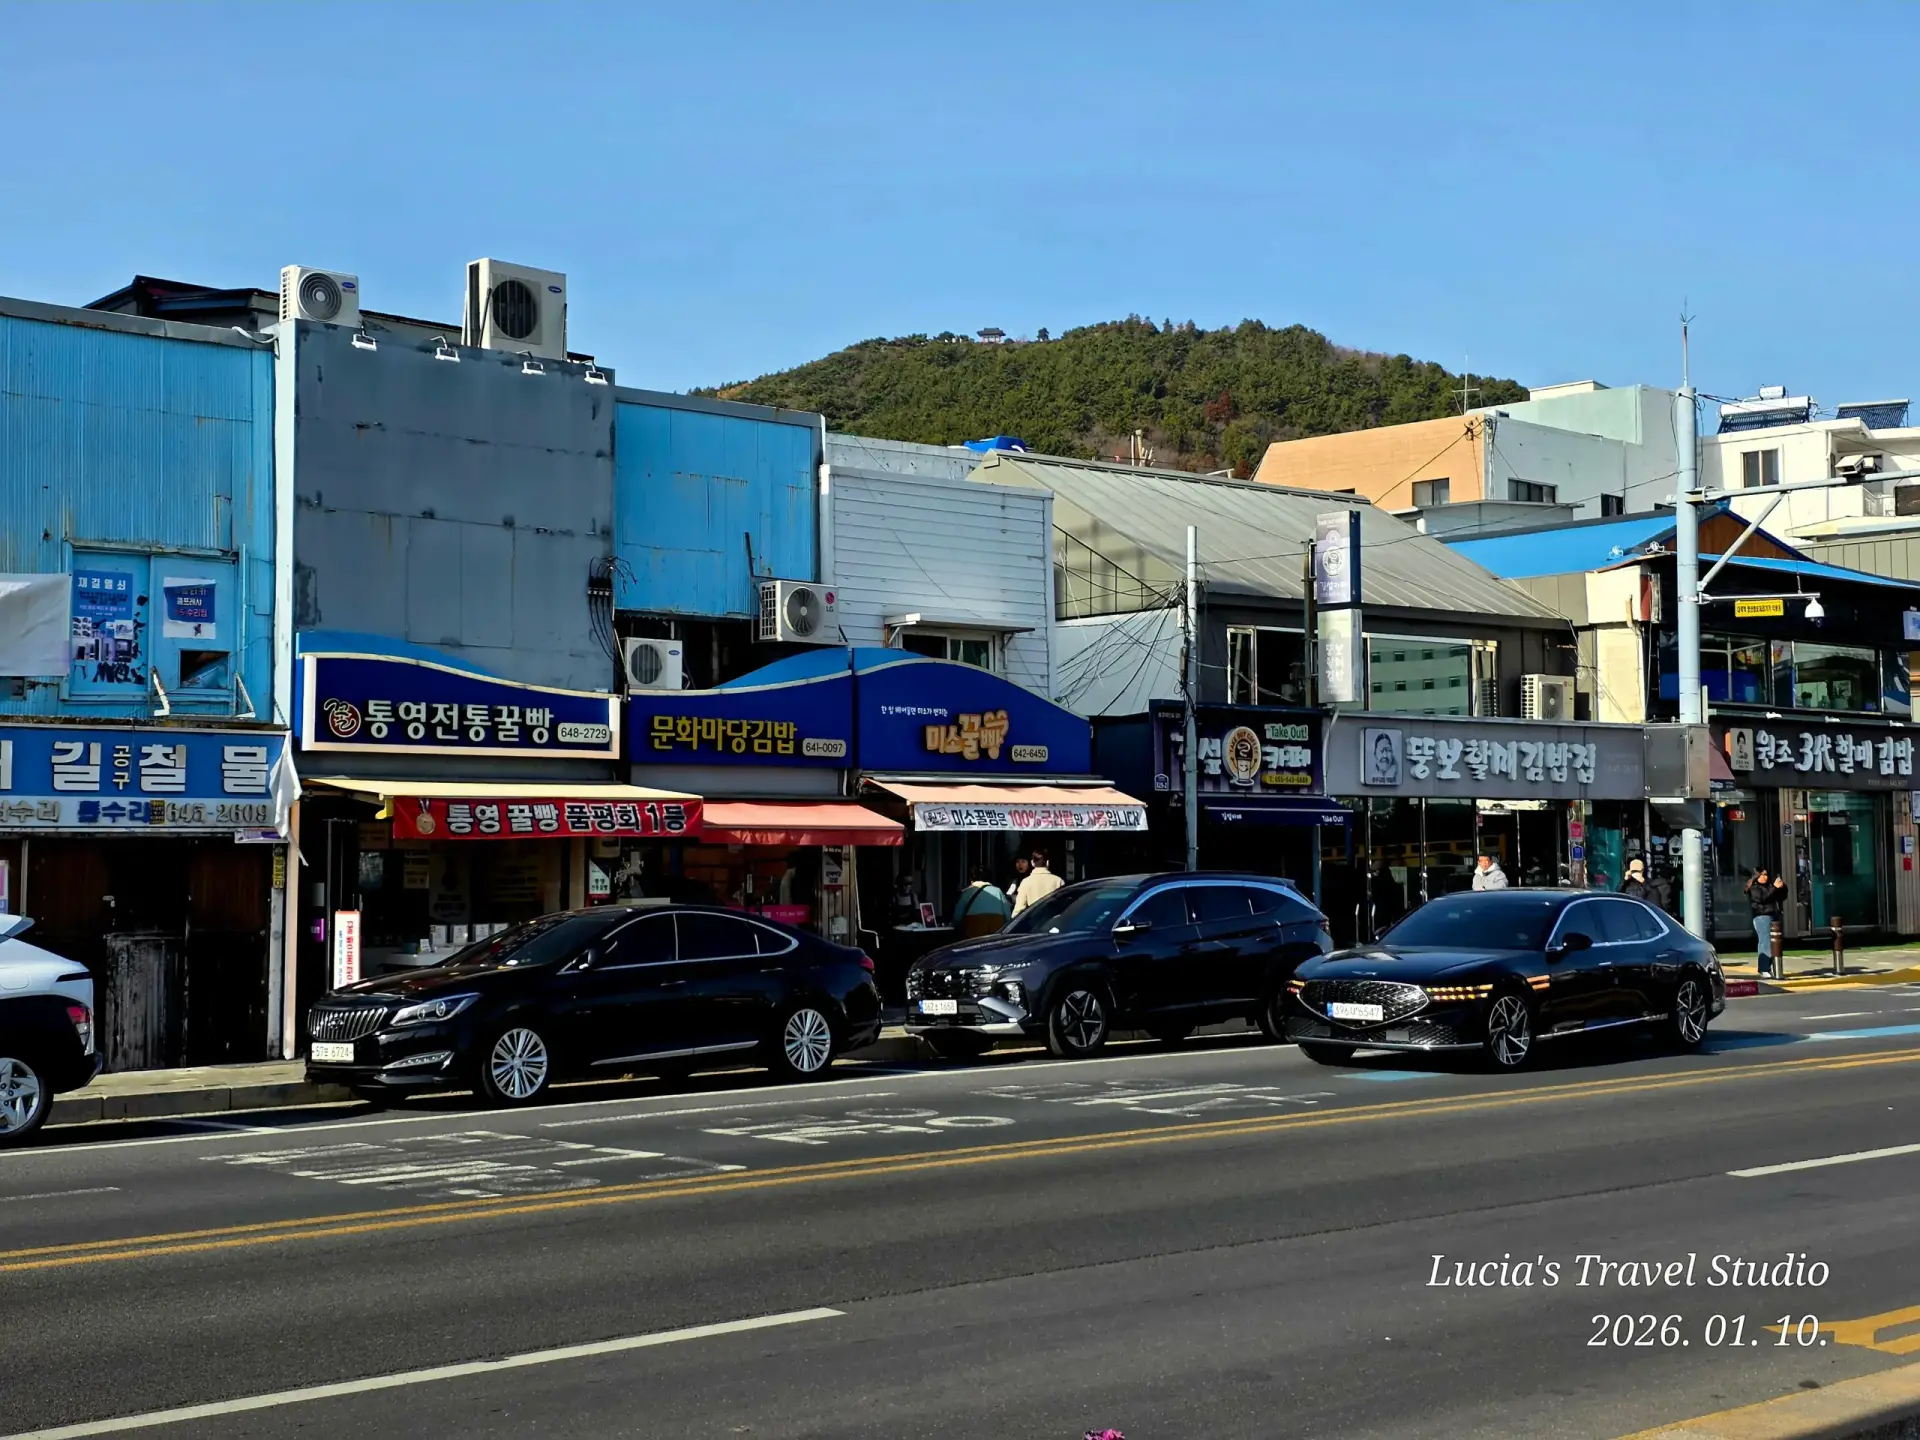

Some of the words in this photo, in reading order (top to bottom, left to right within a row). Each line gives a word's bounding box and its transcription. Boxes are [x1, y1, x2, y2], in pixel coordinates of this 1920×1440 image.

[365, 700, 554, 744] 통영전통꿀빵
[560, 727, 608, 740] 648-2729
[1270, 725, 1289, 738] Take
[651, 715, 798, 755] 문화마당김밥
[805, 742, 843, 754] 641-0097
[1013, 747, 1047, 759] 642-6450
[1755, 730, 1795, 770] 원조
[1794, 732, 1836, 772] 3代
[1835, 734, 1873, 774] 할매
[1874, 736, 1915, 775] 김밥
[112, 745, 131, 790] 공구
[446, 803, 500, 834] 통영
[507, 802, 559, 833] 꿀빵
[564, 802, 640, 833] 품평회
[645, 803, 688, 832] 1등
[951, 809, 988, 826] 미소꿀빵은
